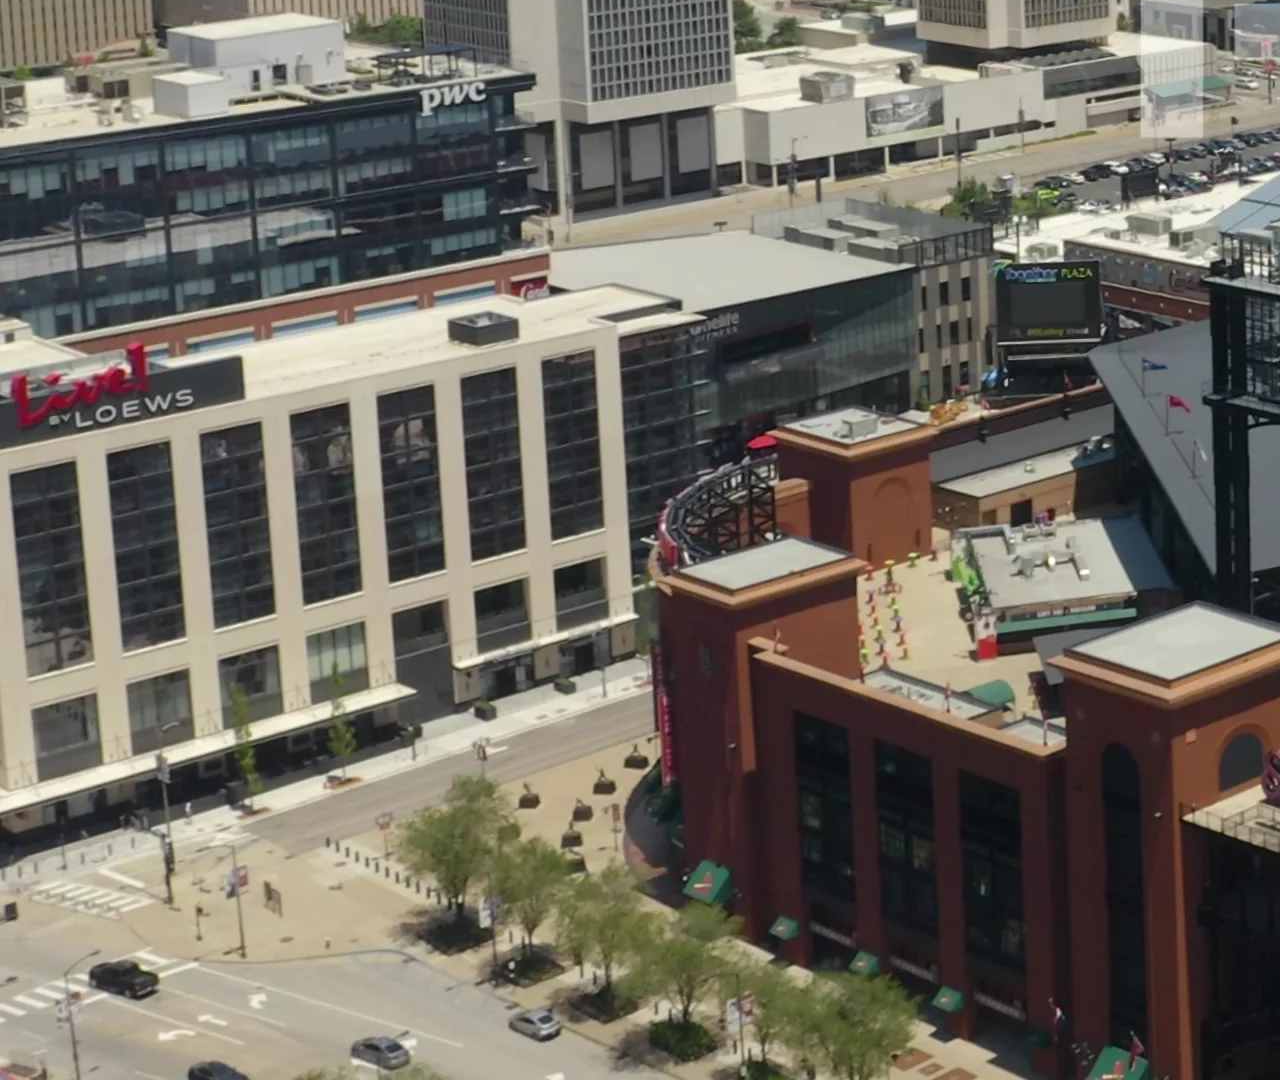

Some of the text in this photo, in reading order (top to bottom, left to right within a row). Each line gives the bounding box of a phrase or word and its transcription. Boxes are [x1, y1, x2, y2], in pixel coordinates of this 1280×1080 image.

[420, 82, 487, 117] pwc
[1061, 268, 1093, 278] PLAZA
[10, 341, 151, 428] Live!
[75, 389, 194, 428] LOEWS
